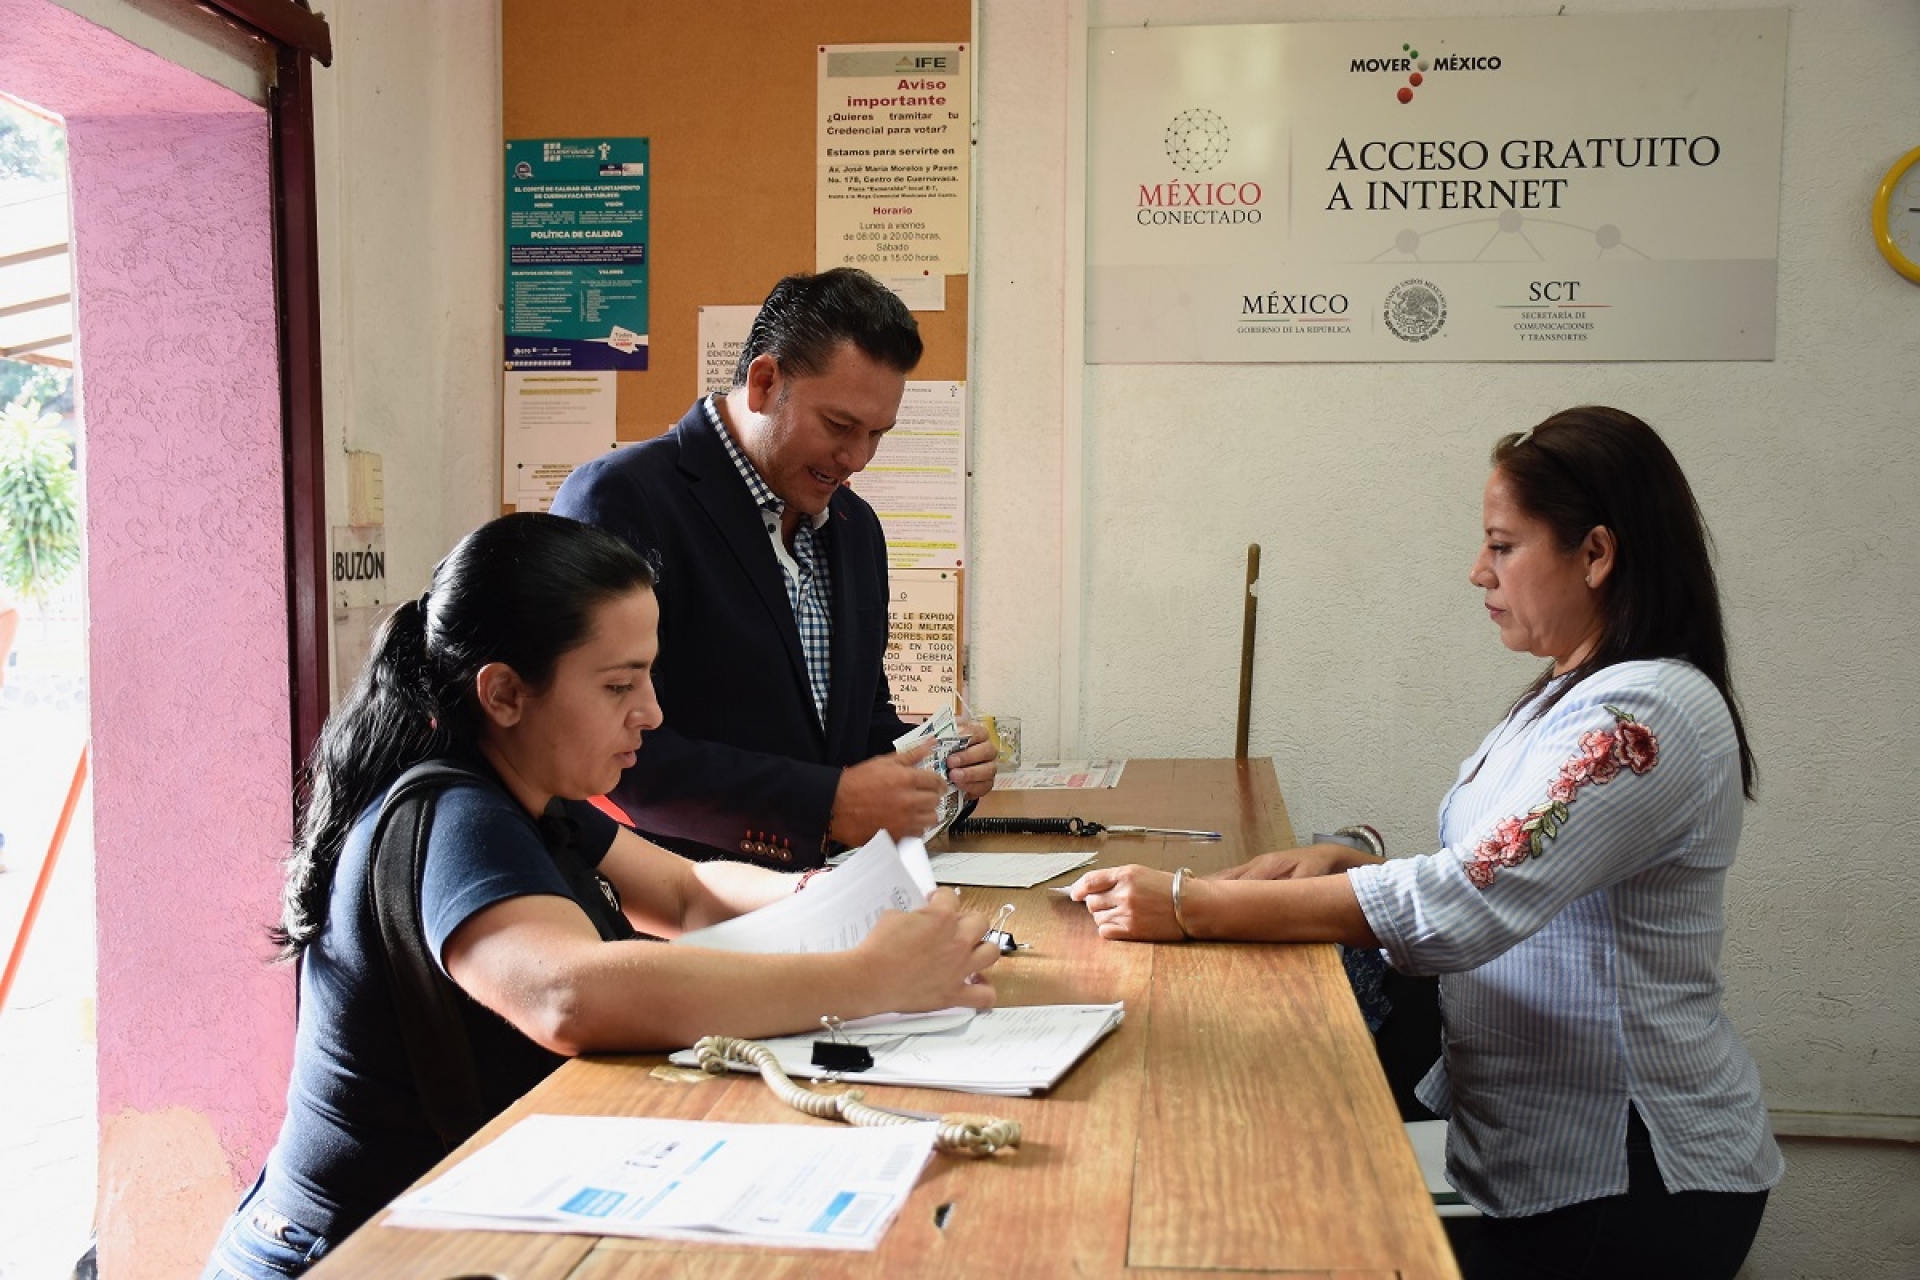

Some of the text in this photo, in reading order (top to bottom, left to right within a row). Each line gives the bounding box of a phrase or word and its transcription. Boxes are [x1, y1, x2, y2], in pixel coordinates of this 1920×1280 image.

[915, 57, 947, 68] IFE
[1350, 53, 1502, 72] MOVER MÉXICO
[897, 79, 947, 90] Aviso
[847, 95, 947, 109] importante
[827, 113, 874, 123] ¿Quieres
[889, 112, 933, 120] tramitar
[827, 125, 947, 136] Credencial para votar?
[827, 148, 870, 157] Estamos
[873, 149, 896, 157] para
[898, 147, 940, 155] servirte
[1326, 136, 1720, 171] ACCESO GRATUITO
[843, 165, 863, 173] José
[890, 164, 923, 172] Morelos
[863, 175, 892, 183] Centro
[1137, 179, 1262, 207] MÉXICO
[1326, 179, 1568, 211] A INTERNET
[873, 206, 913, 215] Horario
[1137, 209, 1262, 226] CONECTADO
[859, 222, 886, 230] Lunes
[895, 222, 926, 230] viernes
[531, 229, 624, 239] POLÍTICA DE CALIDAD
[843, 233, 855, 241] de
[889, 232, 914, 241] 20:00
[876, 243, 910, 251] Sábado
[843, 255, 855, 263] de
[856, 254, 880, 263] 09:00
[890, 254, 914, 262] 15:00
[1528, 281, 1581, 302] SCT
[1242, 291, 1349, 314] MÉXICO
[1521, 310, 1586, 319] SECRETARÍA DE
[1237, 326, 1281, 334] GOBIERNO
[1282, 326, 1294, 334] DE
[1306, 324, 1351, 334] REPÚBLICA
[1514, 322, 1595, 331] COMUNICACIONES
[1521, 333, 1588, 341] Y TRANSPORTES
[335, 543, 385, 581] BUZÓN
[903, 612, 914, 620] LE
[888, 622, 955, 632] VICIO MILITAR
[888, 632, 954, 642] RIORES, NO SE
[909, 643, 922, 651] EN
[928, 643, 954, 651] TODO
[883, 663, 912, 672] SICIÓN
[921, 665, 933, 673] DE
[928, 684, 954, 693] ZONA
